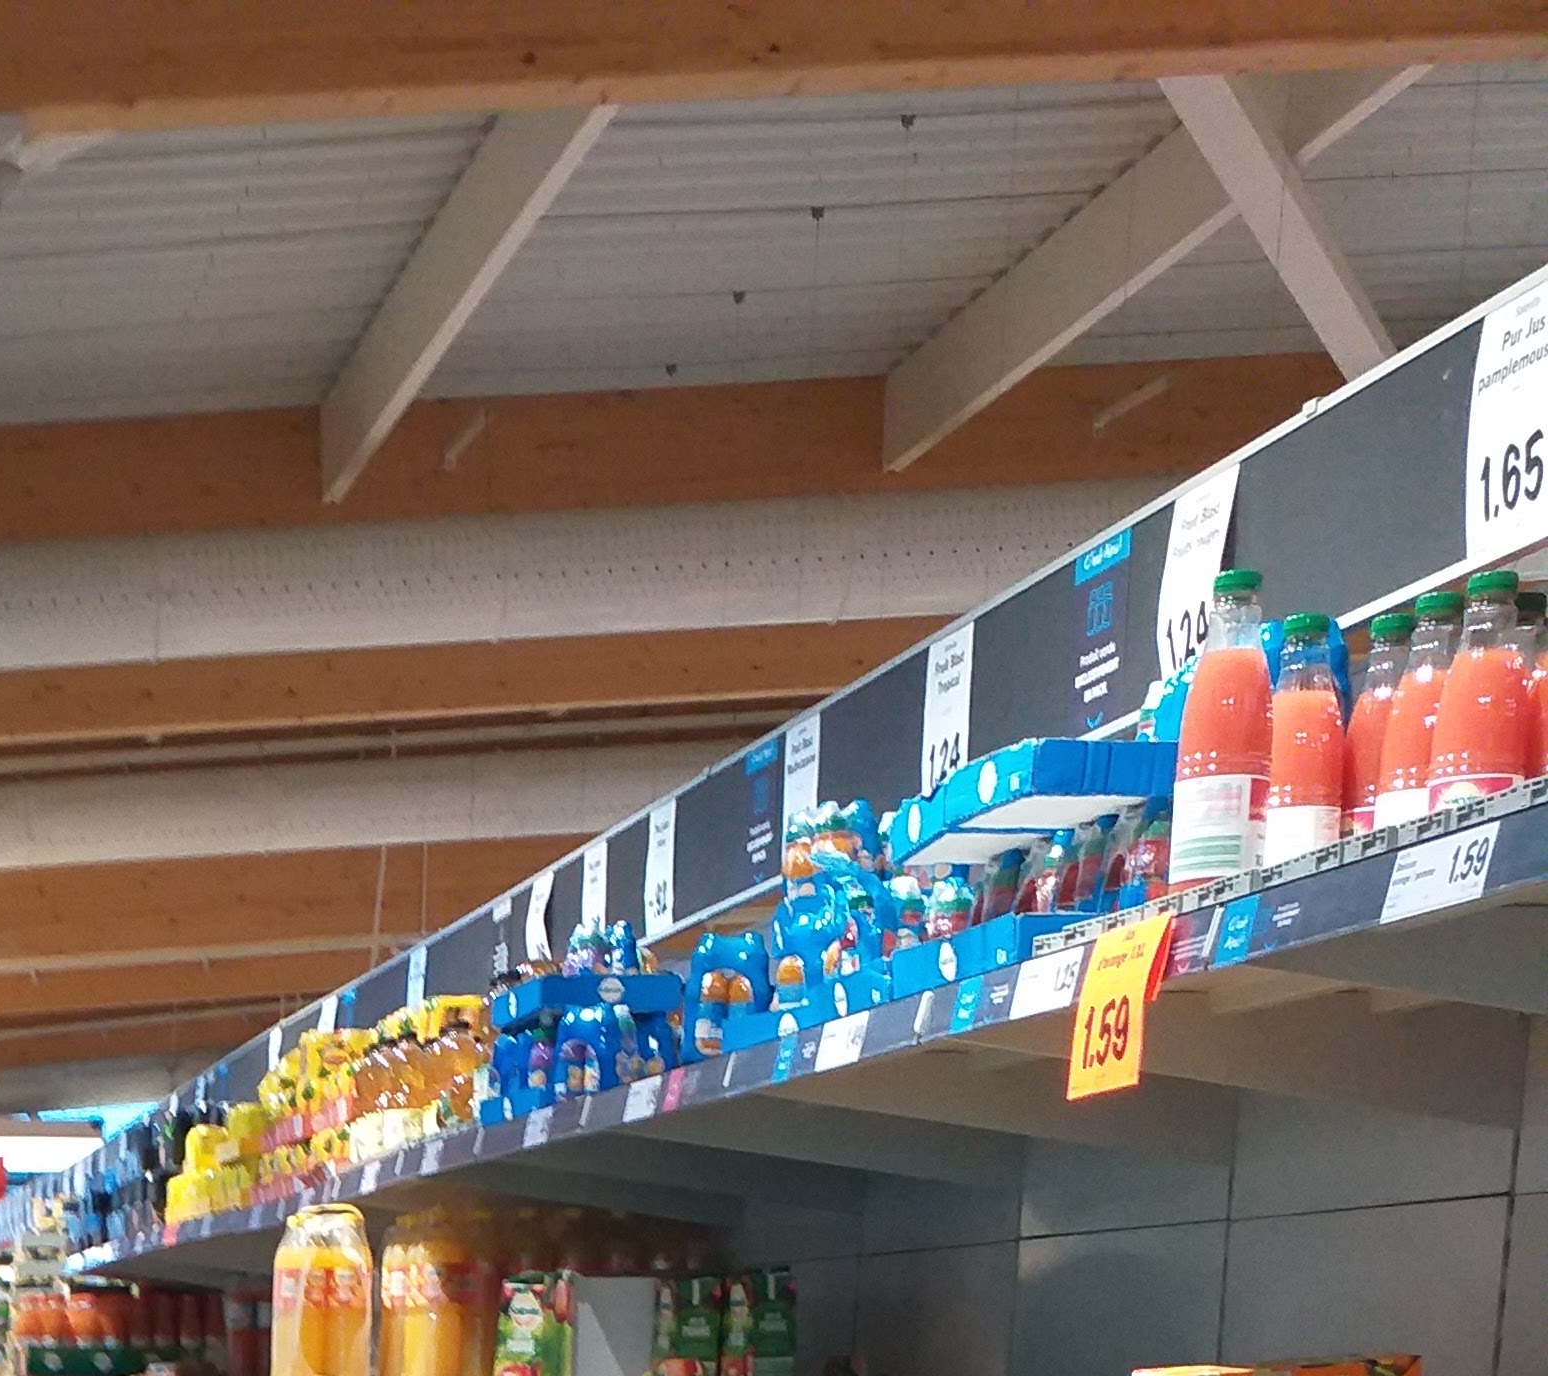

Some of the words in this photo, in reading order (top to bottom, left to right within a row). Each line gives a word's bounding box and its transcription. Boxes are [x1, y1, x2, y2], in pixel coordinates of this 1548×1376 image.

[1501, 328, 1523, 352] Pur
[1525, 313, 1547, 343] Jus
[1480, 429, 1544, 523] 1.65
[1447, 836, 1490, 885] 1.59
[1082, 994, 1130, 1069] 1.59
